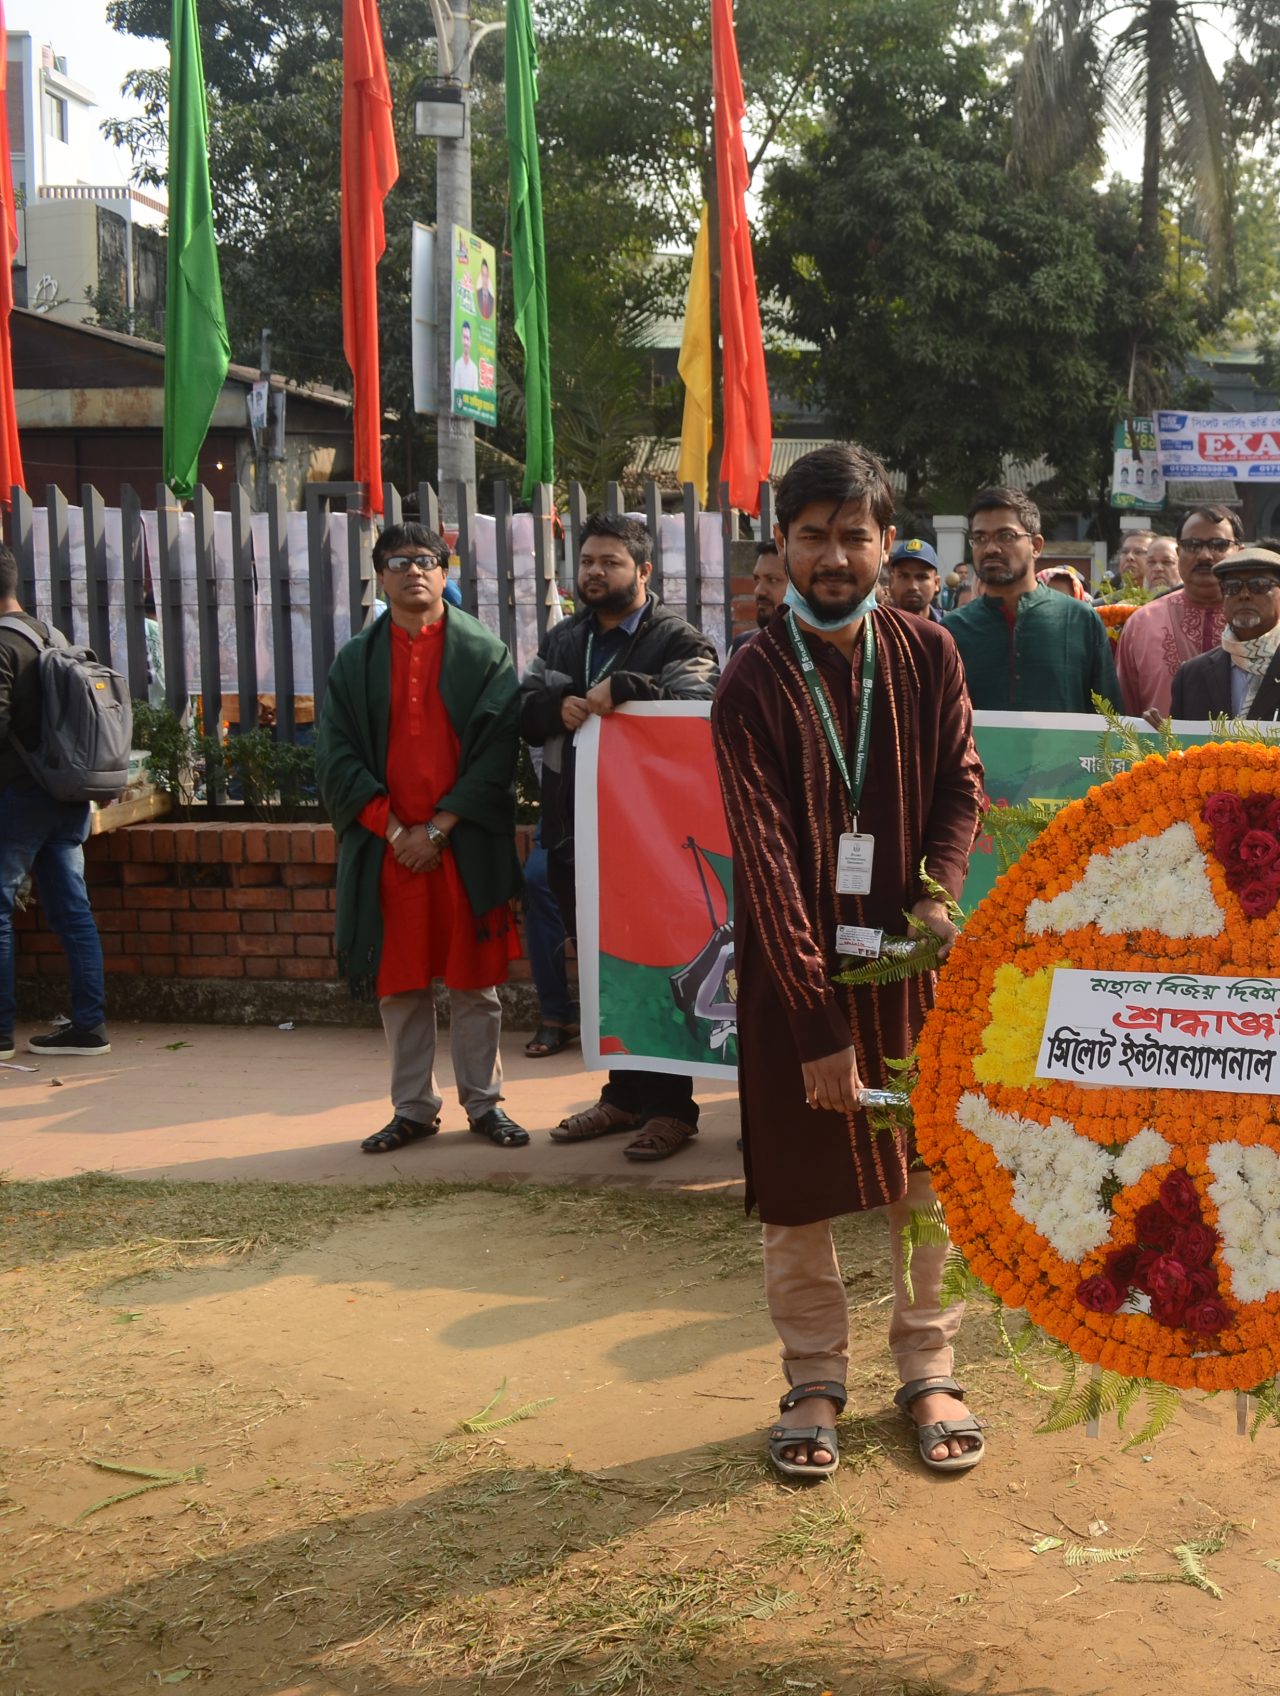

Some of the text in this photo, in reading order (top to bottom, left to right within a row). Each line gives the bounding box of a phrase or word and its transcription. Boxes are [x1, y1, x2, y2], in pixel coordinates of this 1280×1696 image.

[1191, 414, 1219, 429] সিলেট
[1204, 434, 1280, 456] EXA
[1089, 976, 1152, 999] মহান
[1156, 974, 1219, 1001] বিজয়
[1227, 978, 1280, 1003] দিবস
[1047, 1025, 1116, 1075] সিলেট
[1118, 1032, 1276, 1083] ইন্টারন্যাশনাল
